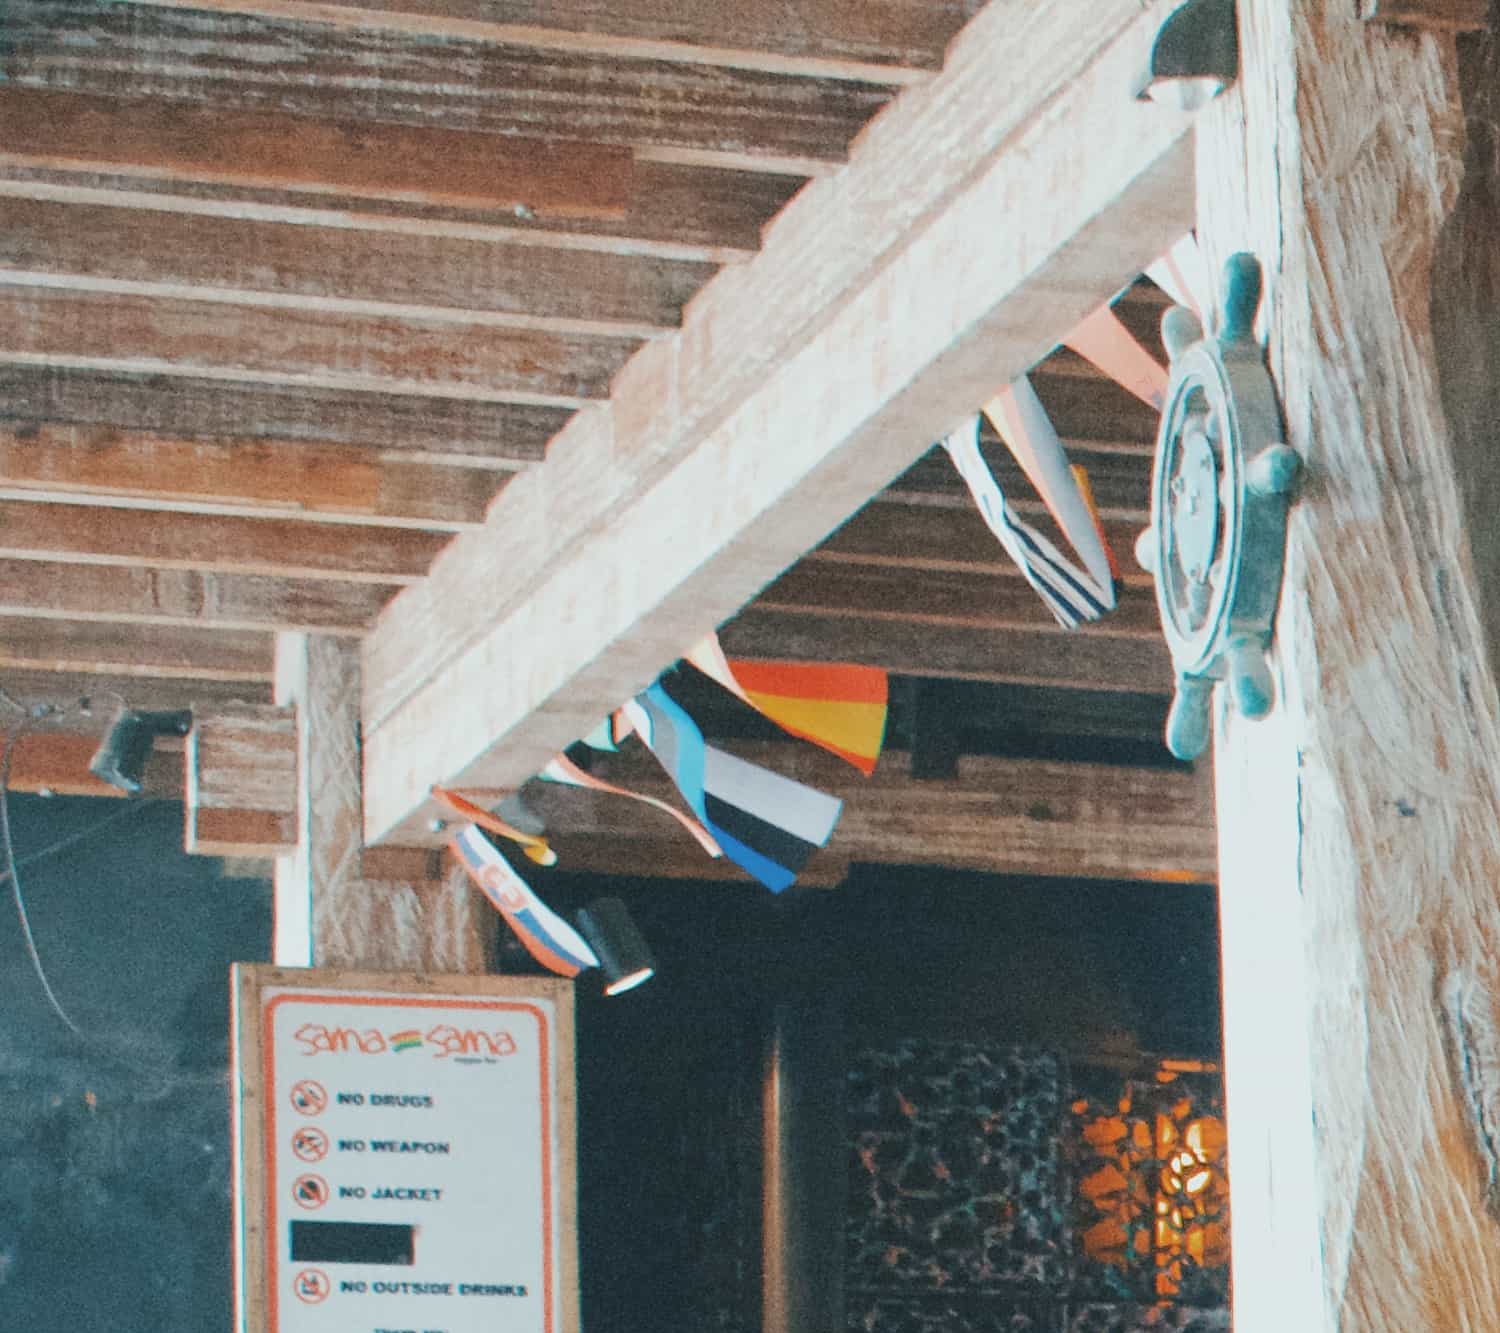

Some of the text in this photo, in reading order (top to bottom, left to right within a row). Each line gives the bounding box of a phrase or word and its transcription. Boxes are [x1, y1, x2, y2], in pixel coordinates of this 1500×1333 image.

[336, 1092, 434, 1109] NO DRUGS
[338, 1139, 450, 1155] NO WEAPON
[338, 1186, 443, 1202] NO JACKET
[340, 1280, 529, 1298] NO OUTSIDE DRINKS
